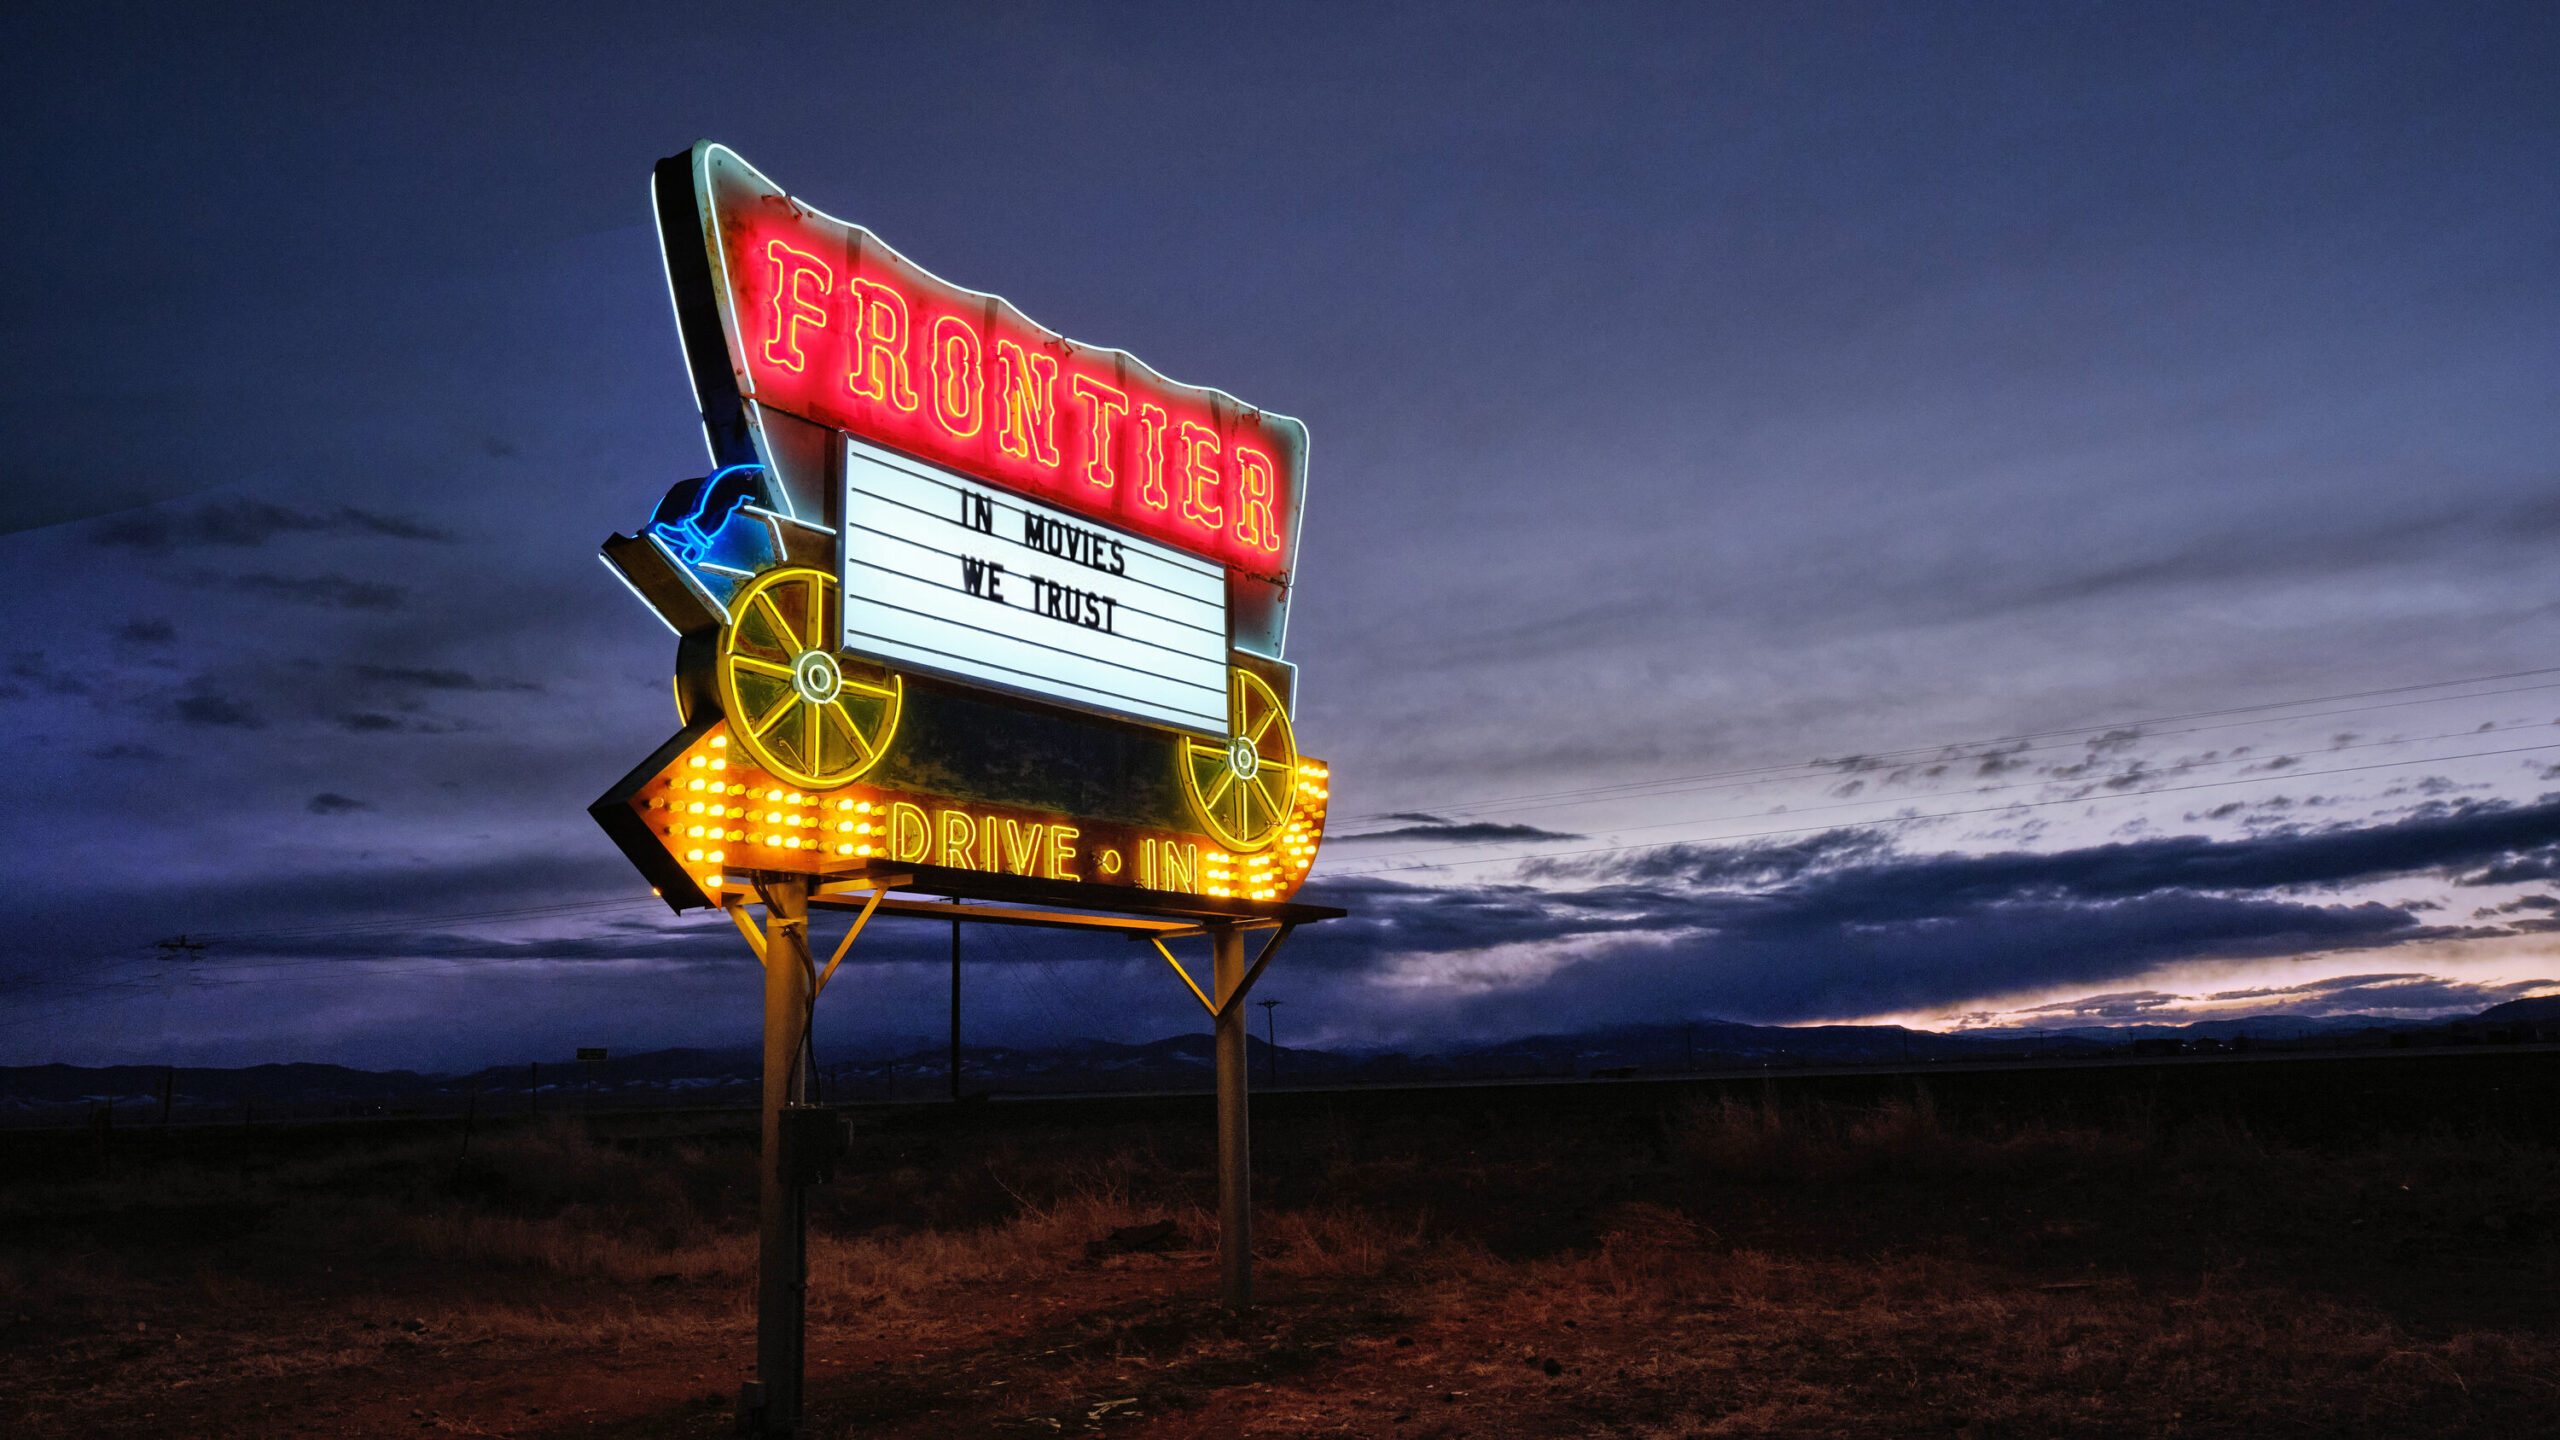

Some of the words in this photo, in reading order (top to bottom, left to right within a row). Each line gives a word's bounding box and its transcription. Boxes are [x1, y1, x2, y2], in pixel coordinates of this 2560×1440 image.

[765, 239, 1281, 553] FRONTIER
[962, 488, 993, 535] IN
[1025, 509, 1126, 576] MOVIES
[961, 554, 1004, 605] WE
[1030, 576, 1117, 634] TRUST
[888, 801, 1081, 882] DRIVE
[1140, 838, 1199, 895] IN
